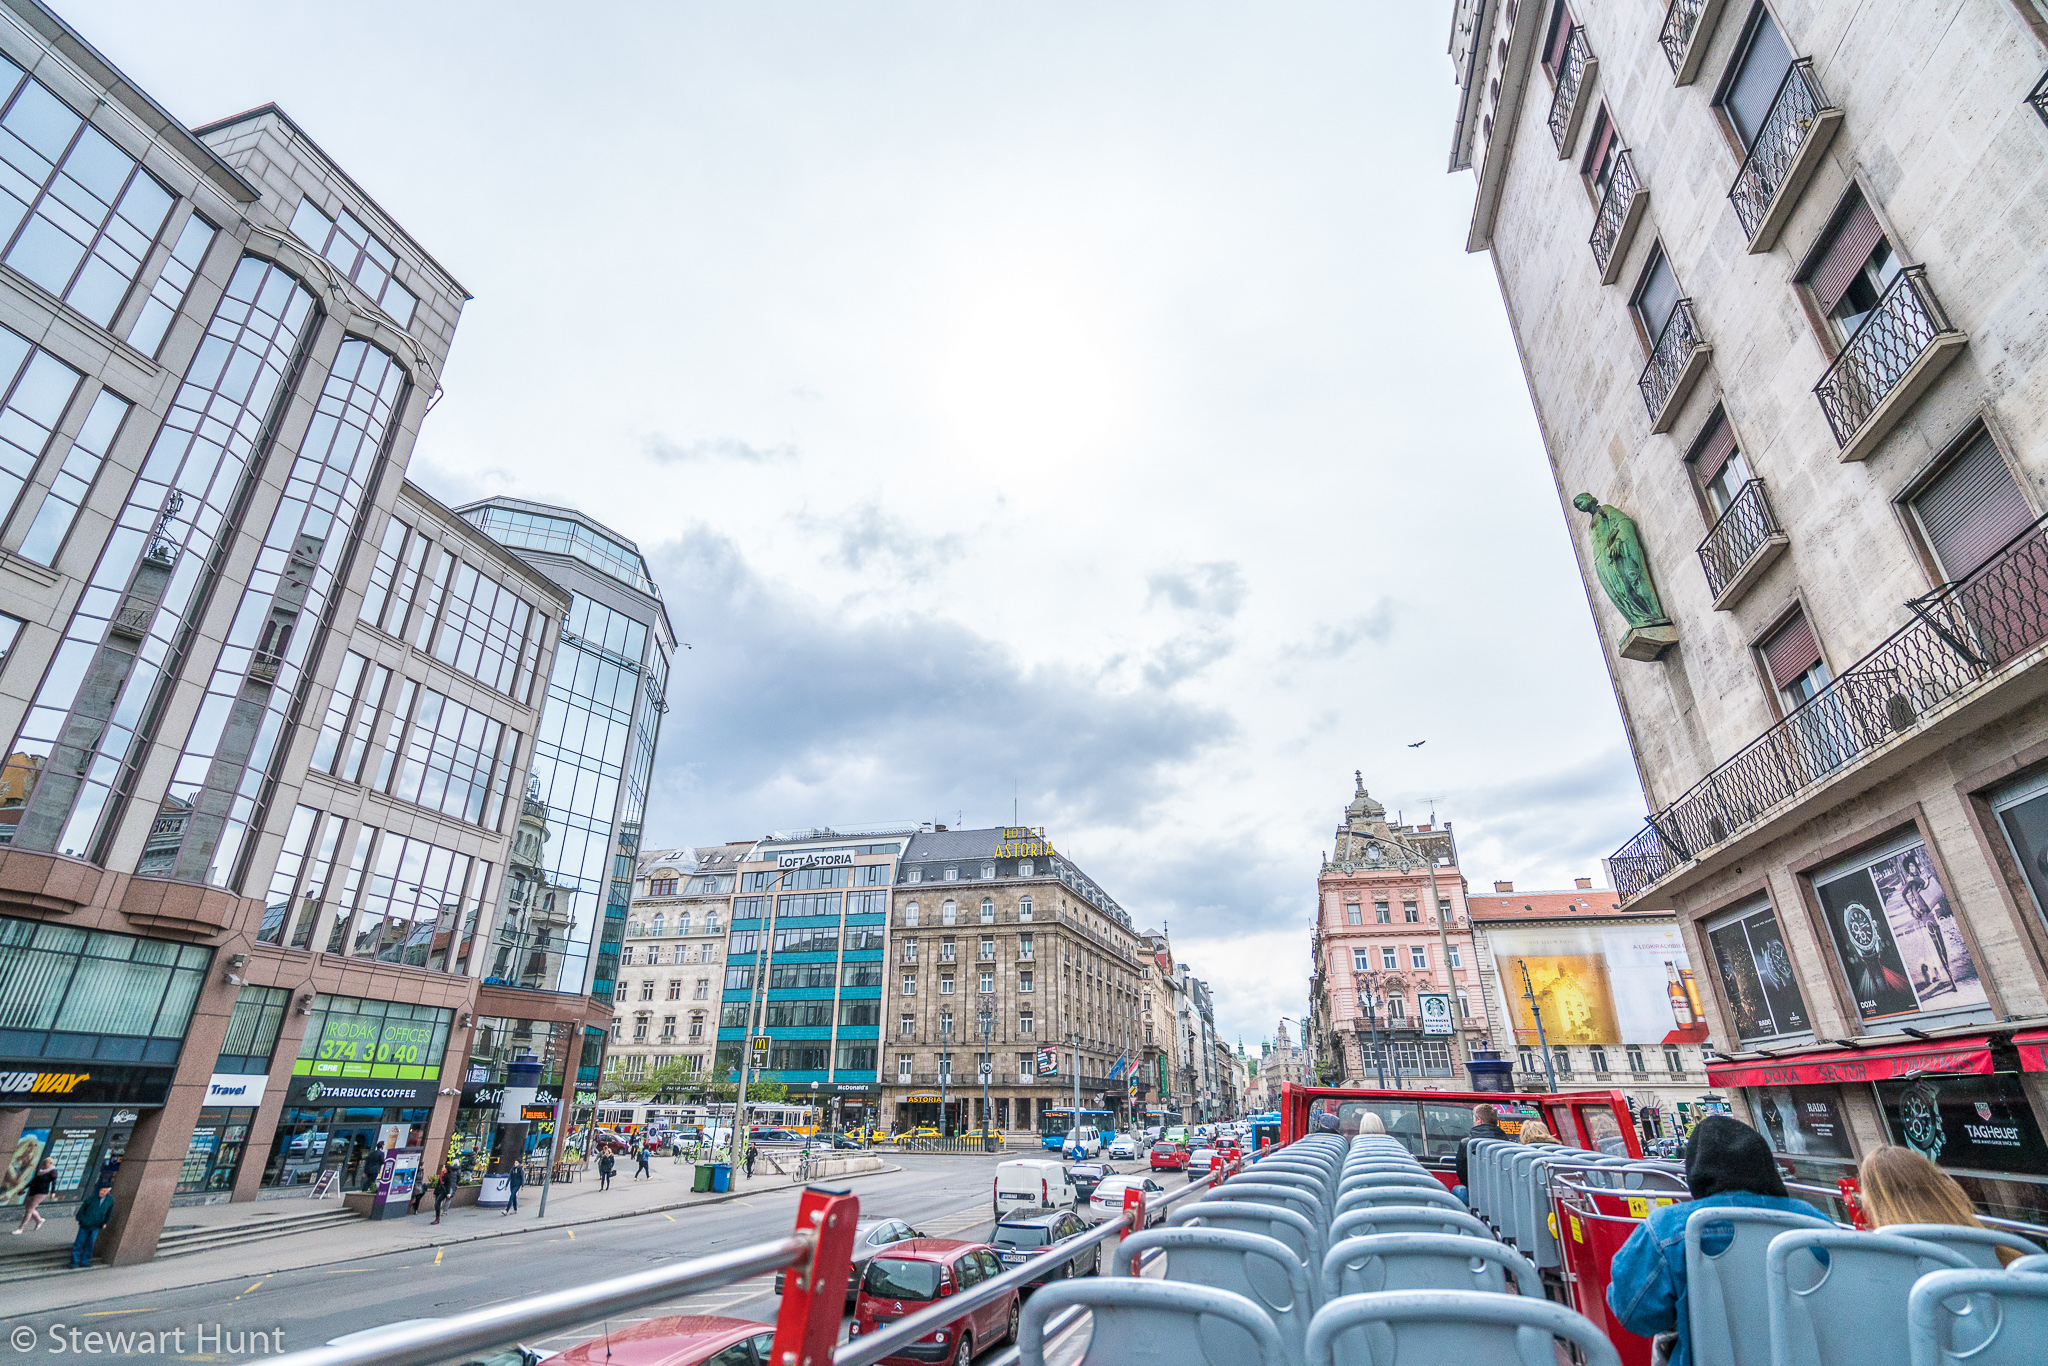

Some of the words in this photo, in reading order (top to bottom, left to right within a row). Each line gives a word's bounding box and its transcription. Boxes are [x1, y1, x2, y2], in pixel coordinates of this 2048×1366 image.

[1003, 826, 1045, 839] HOTEL
[993, 841, 1055, 859] ASTORIA
[779, 856, 805, 868] LOFT
[806, 854, 852, 866] ASTORIA
[1860, 1000, 1877, 1009] DOXA
[325, 1020, 377, 1039] IRODÁK
[384, 1026, 431, 1043] OFFICES
[320, 1039, 358, 1060] 374
[362, 1043, 390, 1062] 30
[393, 1045, 418, 1063] 40
[317, 1064, 339, 1072] CBRE
[1764, 1067, 1800, 1084] DOXA
[1819, 1063, 1867, 1082] SECTOR
[211, 1085, 247, 1095] Travel
[321, 1087, 380, 1098] STARBUCKS
[381, 1088, 417, 1098] COFFEE
[1807, 1103, 1827, 1112] RADO
